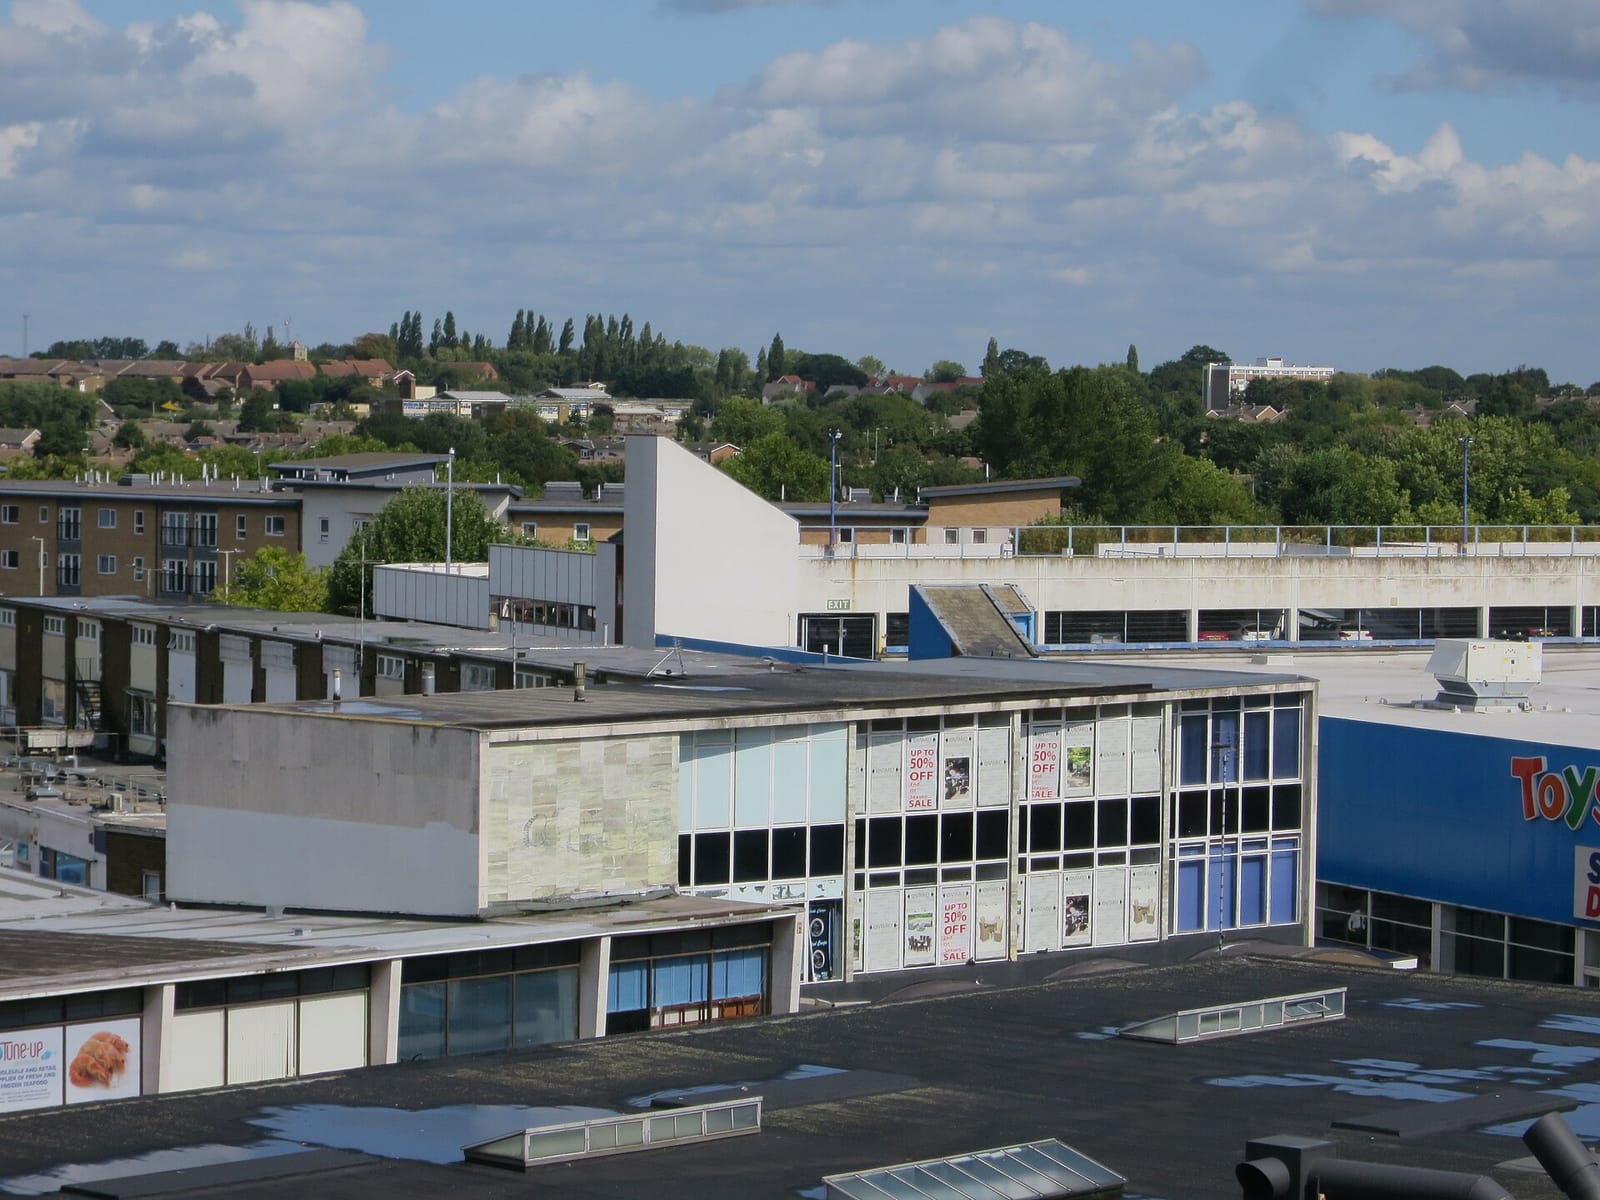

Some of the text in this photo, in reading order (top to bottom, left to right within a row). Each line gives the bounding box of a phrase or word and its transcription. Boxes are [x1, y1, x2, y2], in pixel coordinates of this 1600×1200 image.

[828, 600, 849, 609] EXIT
[1034, 750, 1057, 761] 50%
[910, 757, 934, 769] 50%
[1032, 764, 1056, 773] OFF
[909, 771, 934, 781] OFF
[908, 799, 932, 808] SALE
[944, 902, 968, 912] UP TO
[944, 911, 967, 924] 50%
[944, 924, 967, 936] OFF
[943, 951, 967, 961] SALE
